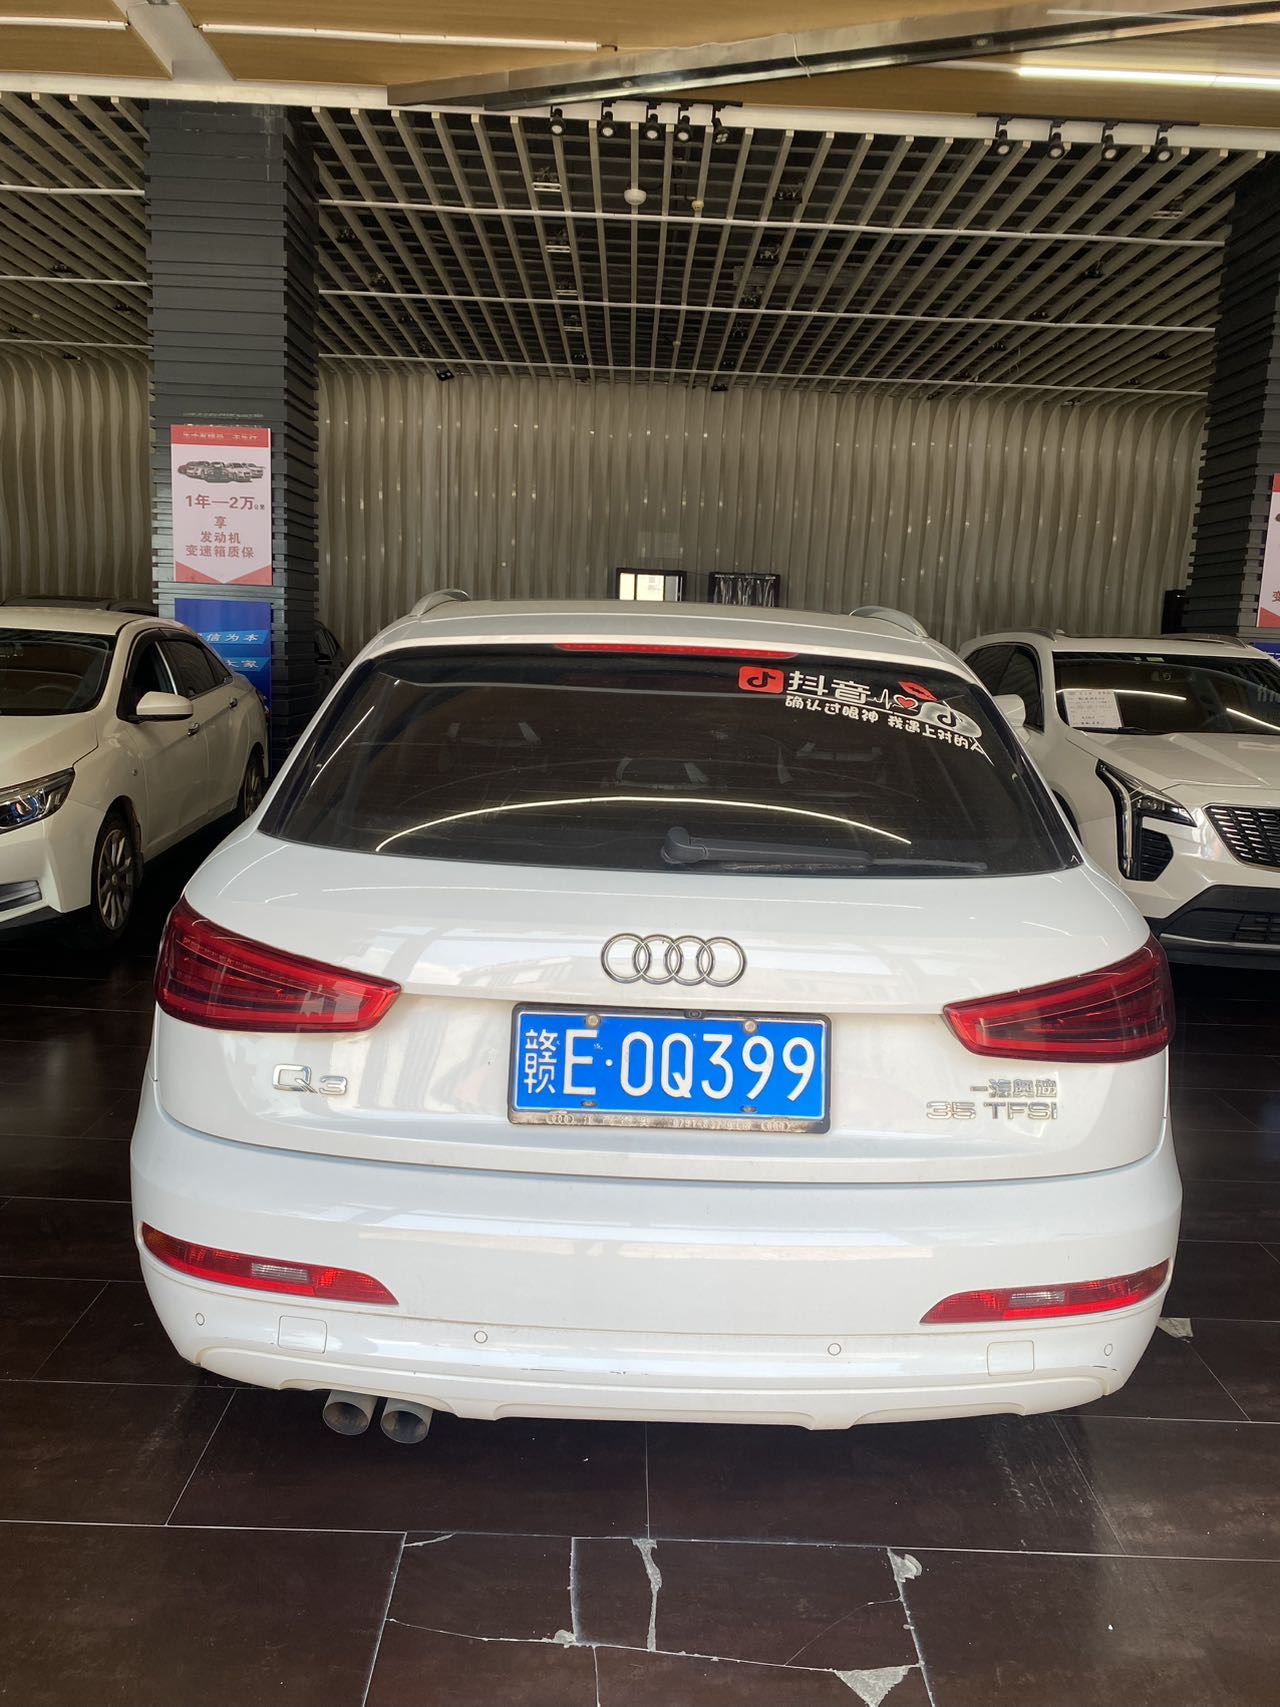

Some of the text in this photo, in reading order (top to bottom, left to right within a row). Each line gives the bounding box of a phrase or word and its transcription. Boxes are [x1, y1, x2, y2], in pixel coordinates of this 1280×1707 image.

[214, 515, 227, 529] 享
[200, 531, 241, 544] 发动机
[185, 544, 254, 558] 变速箱质保
[198, 632, 260, 642] 信为本
[785, 670, 872, 705] 抖音
[784, 695, 986, 757] 确认过眼神 我遇上对的人
[272, 1063, 348, 1096] Q3
[969, 1078, 1058, 1099] 一汽奥迪
[926, 1101, 1058, 1120] 35 TFSI
